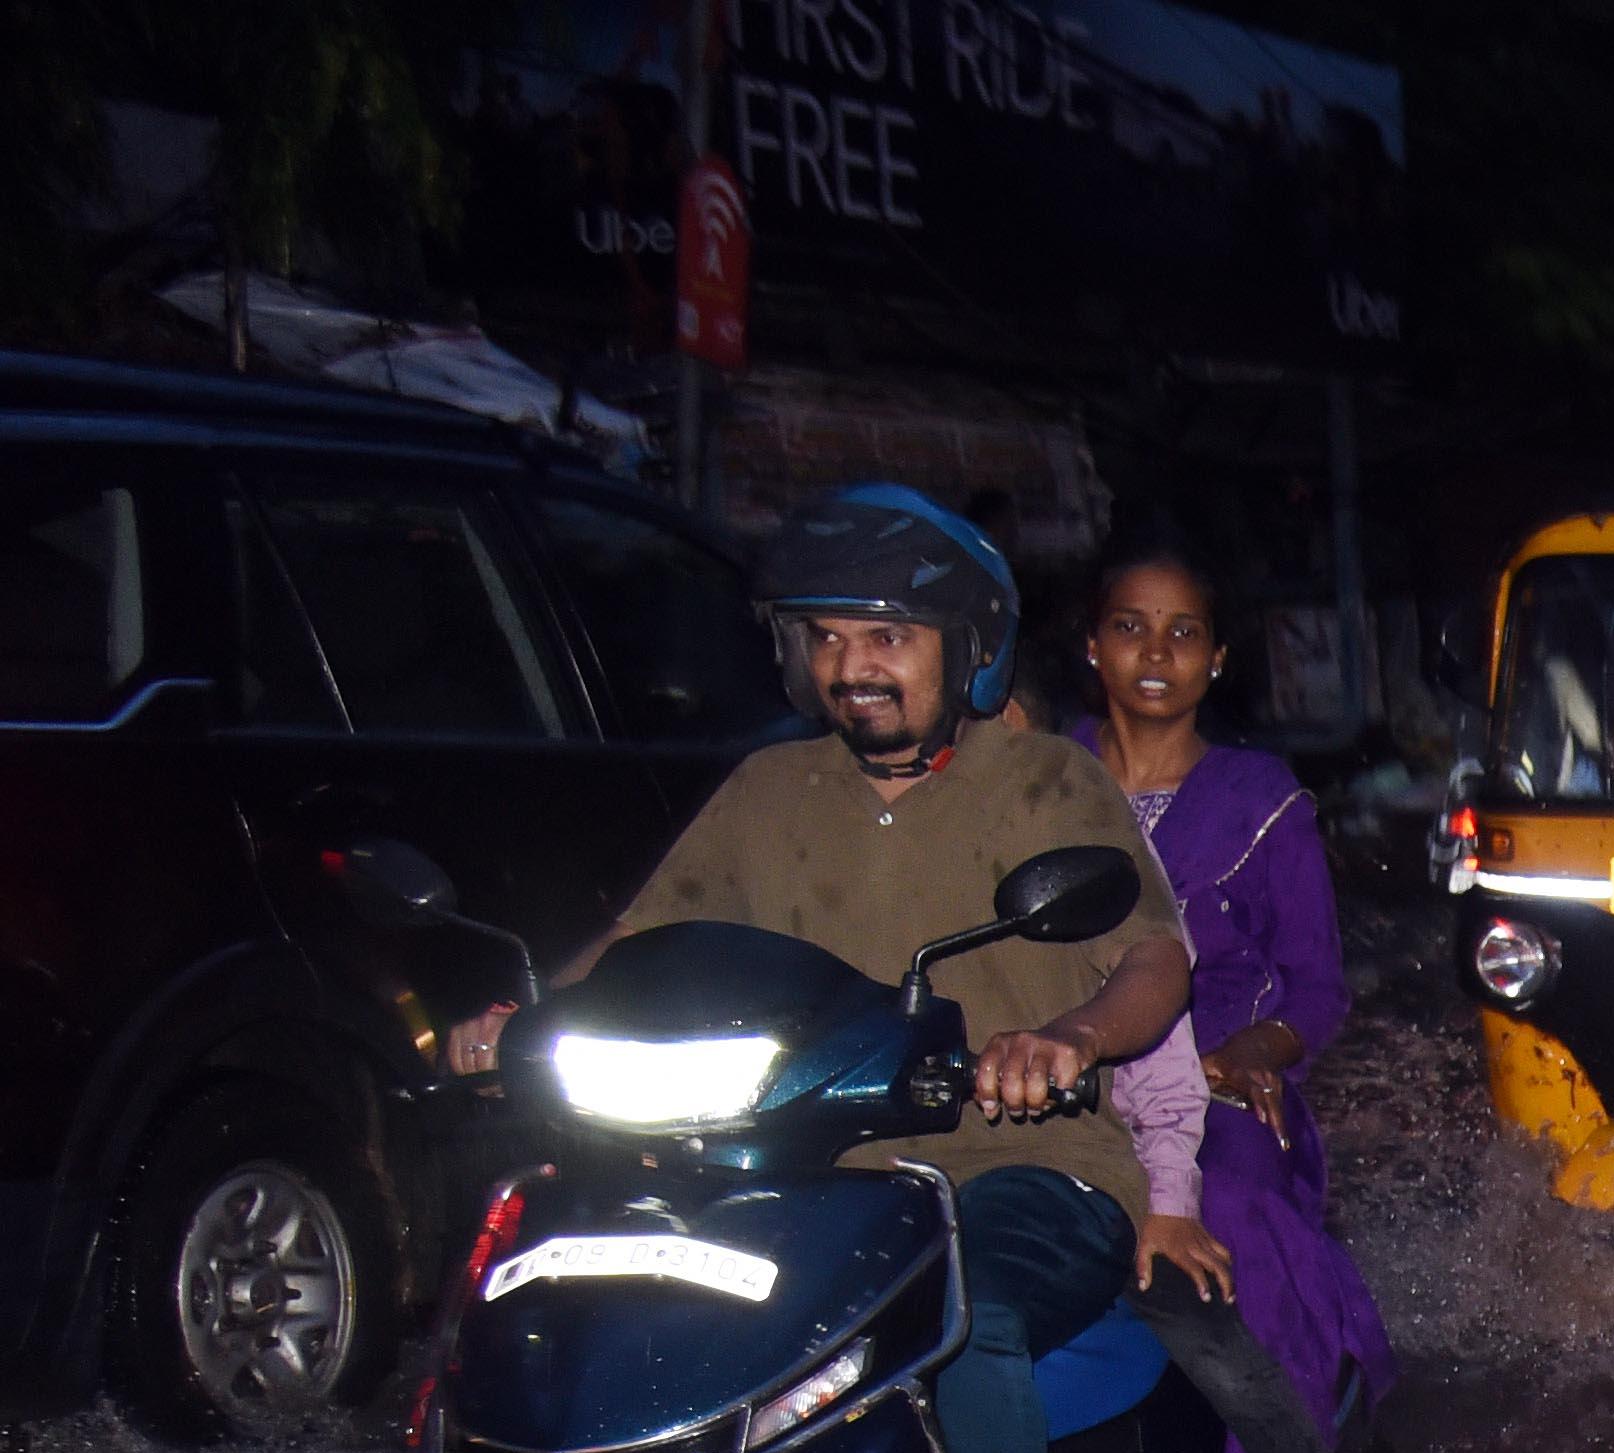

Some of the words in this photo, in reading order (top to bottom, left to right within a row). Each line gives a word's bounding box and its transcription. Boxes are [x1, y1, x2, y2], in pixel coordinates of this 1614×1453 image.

[943, 0, 1098, 131] RIDE
[734, 75, 924, 229] FREE
[576, 205, 676, 255] Ube
